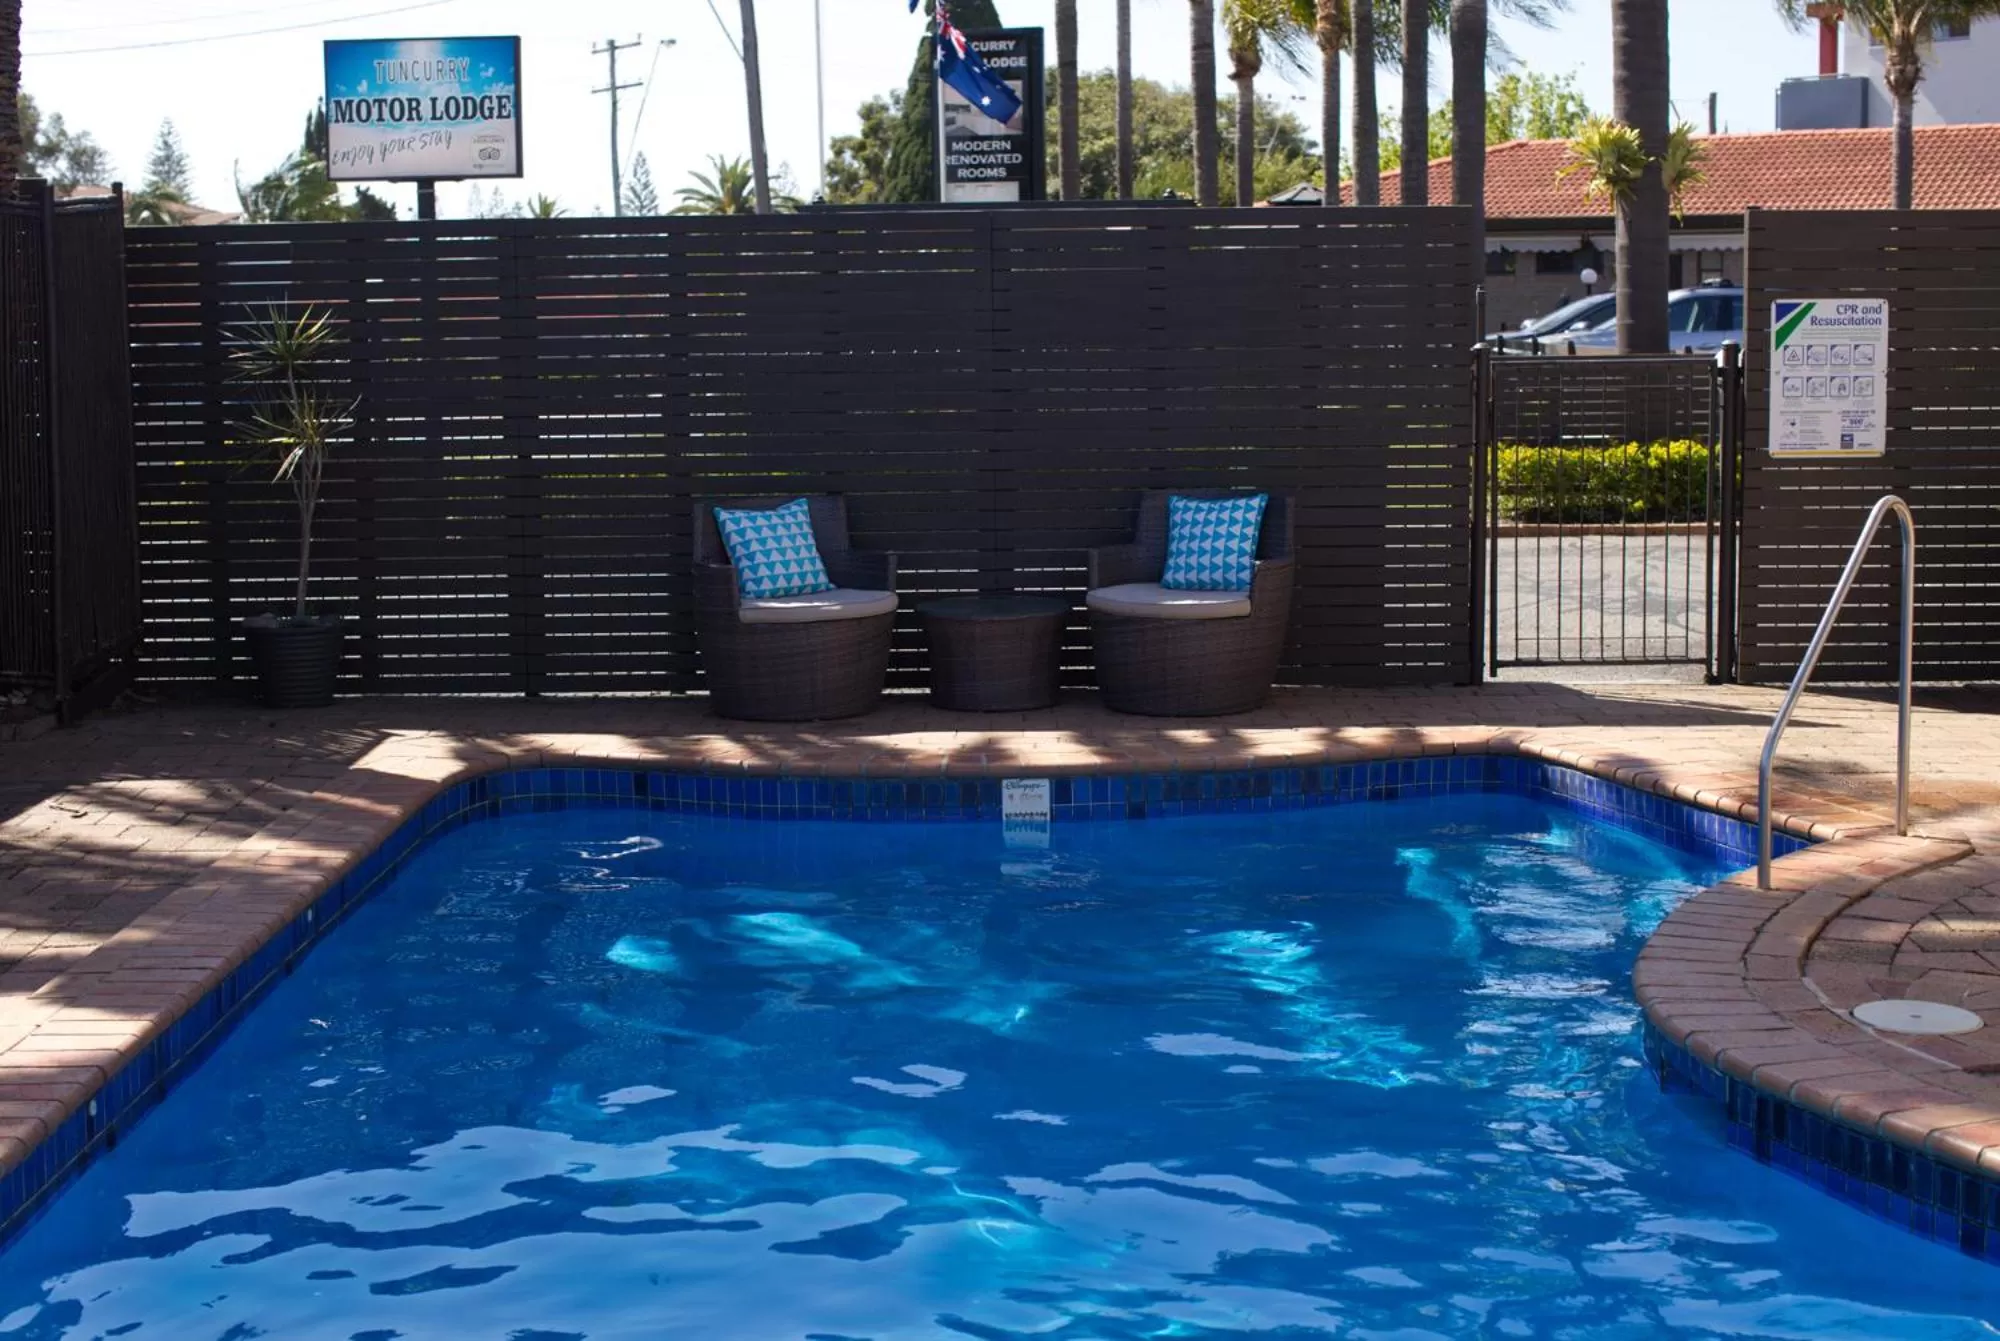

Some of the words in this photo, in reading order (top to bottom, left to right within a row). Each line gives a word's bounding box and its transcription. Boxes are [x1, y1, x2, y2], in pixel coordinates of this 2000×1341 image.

[971, 40, 1016, 52] CURRY
[983, 56, 1027, 68] LODGE
[375, 57, 469, 83] TUNCURRY
[333, 97, 422, 123] MOTOR
[430, 95, 511, 121] LODGE
[952, 140, 1011, 152] MODERN
[957, 167, 1007, 178] ROOMS
[1836, 304, 1859, 315] CPR
[1861, 304, 1882, 315] and
[1810, 315, 1882, 326] Resuscitation
